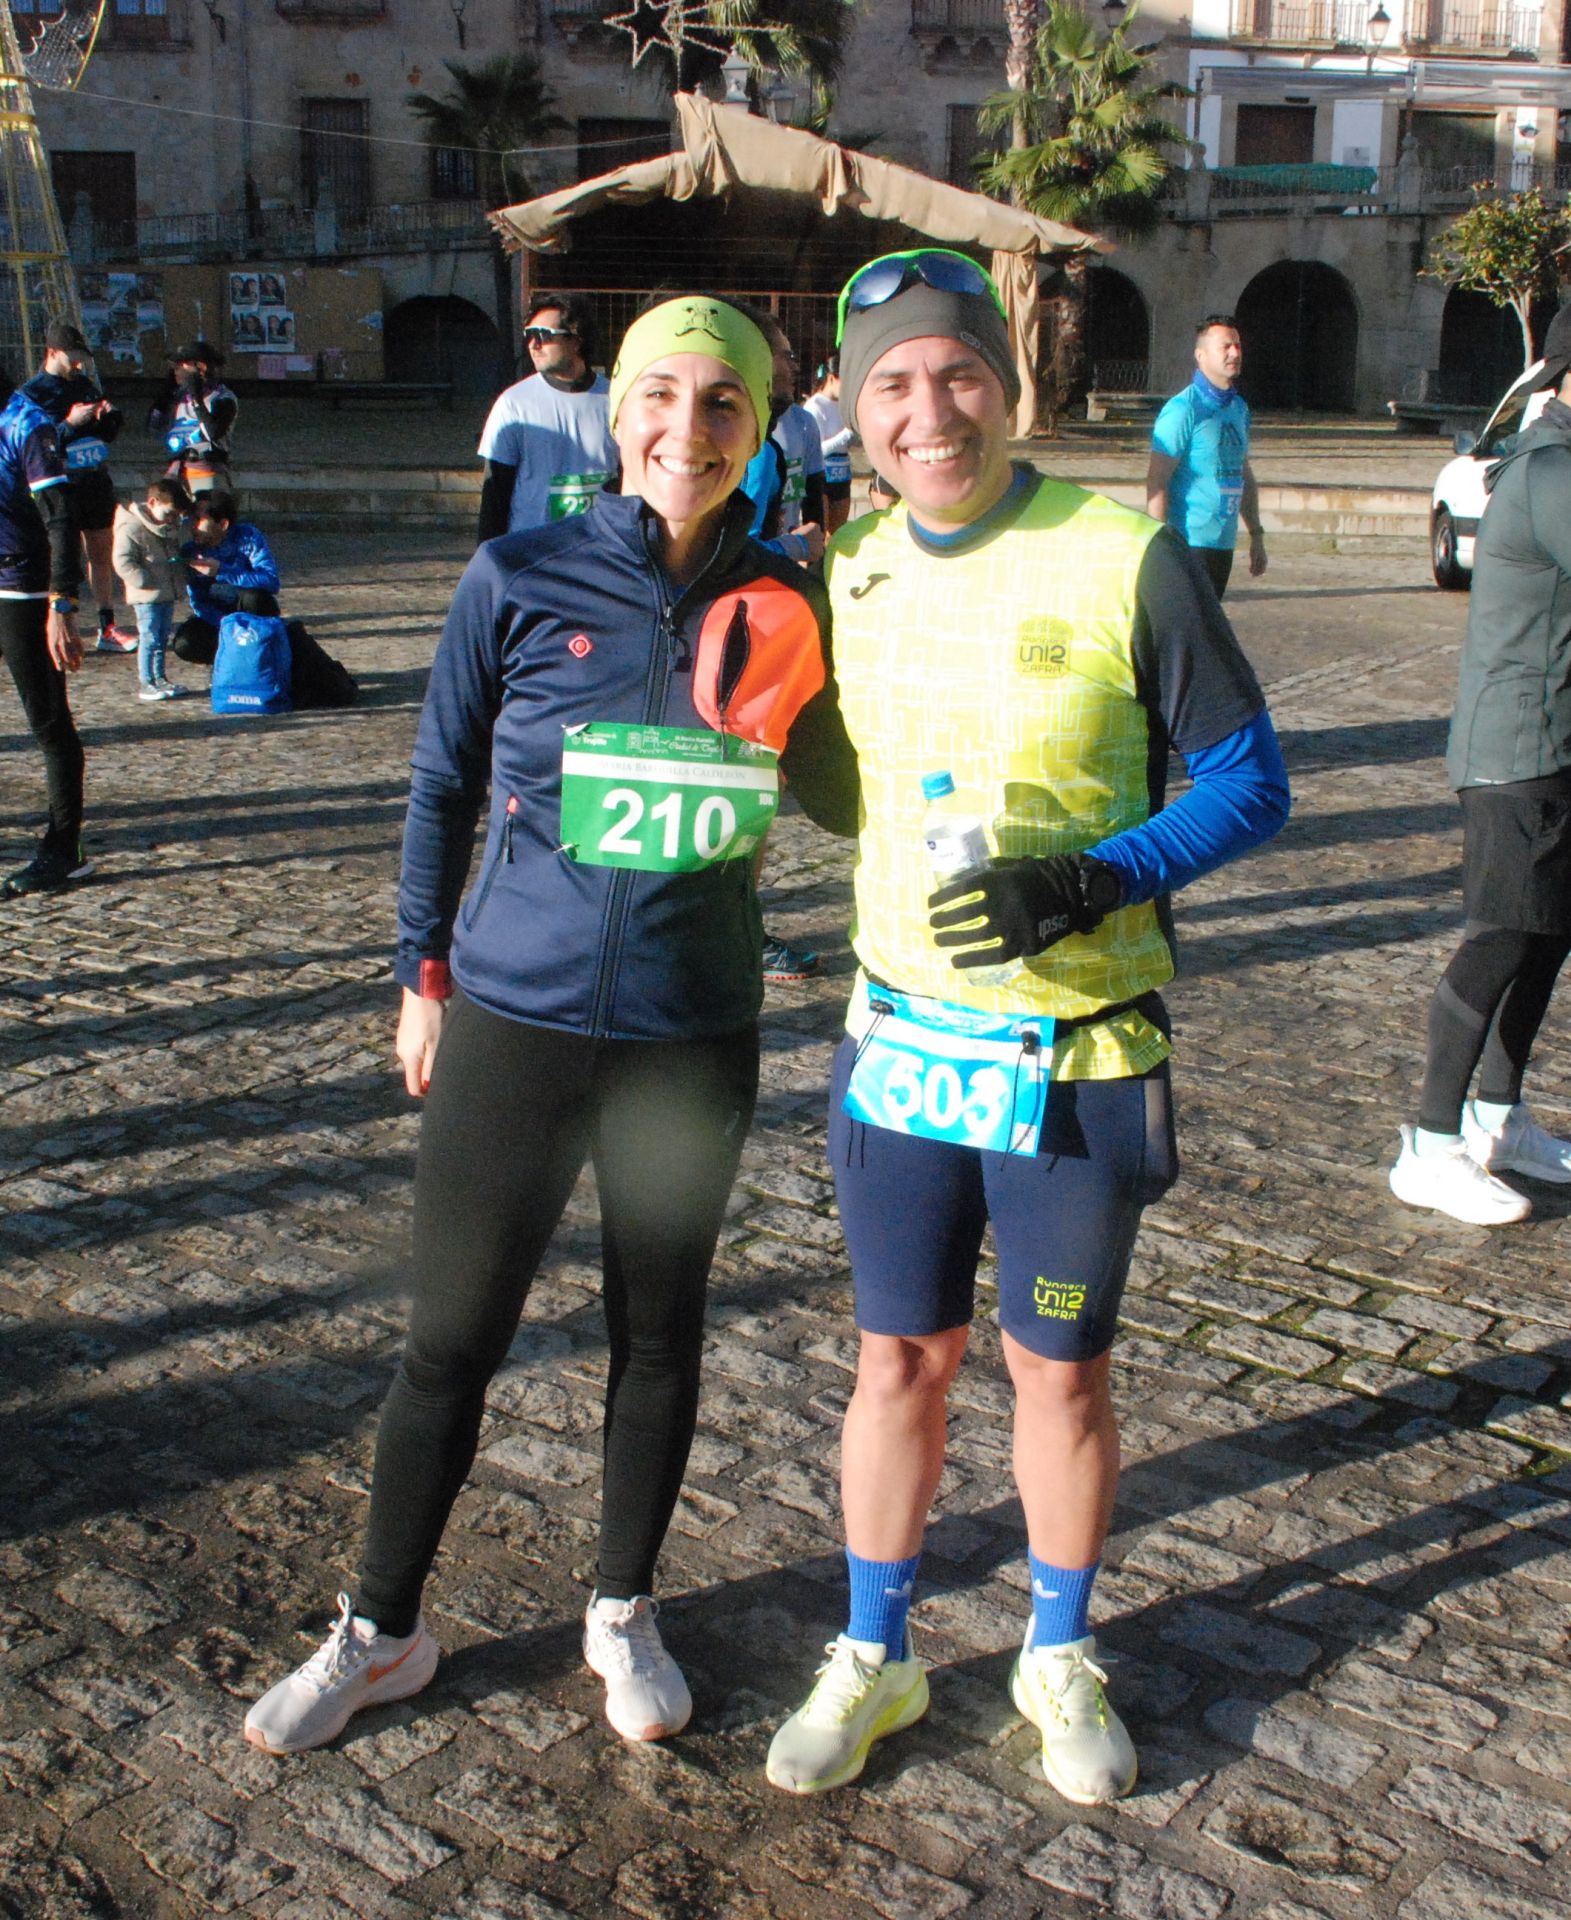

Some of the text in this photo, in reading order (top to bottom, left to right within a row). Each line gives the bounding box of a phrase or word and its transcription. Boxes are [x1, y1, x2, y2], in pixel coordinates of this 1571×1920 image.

[76, 448, 101, 464] 514
[1022, 664, 1062, 674] ZAFRA
[598, 788, 736, 859] 210
[1036, 1276, 1086, 1291] Runners
[1037, 1305, 1077, 1320] ZAFRA
